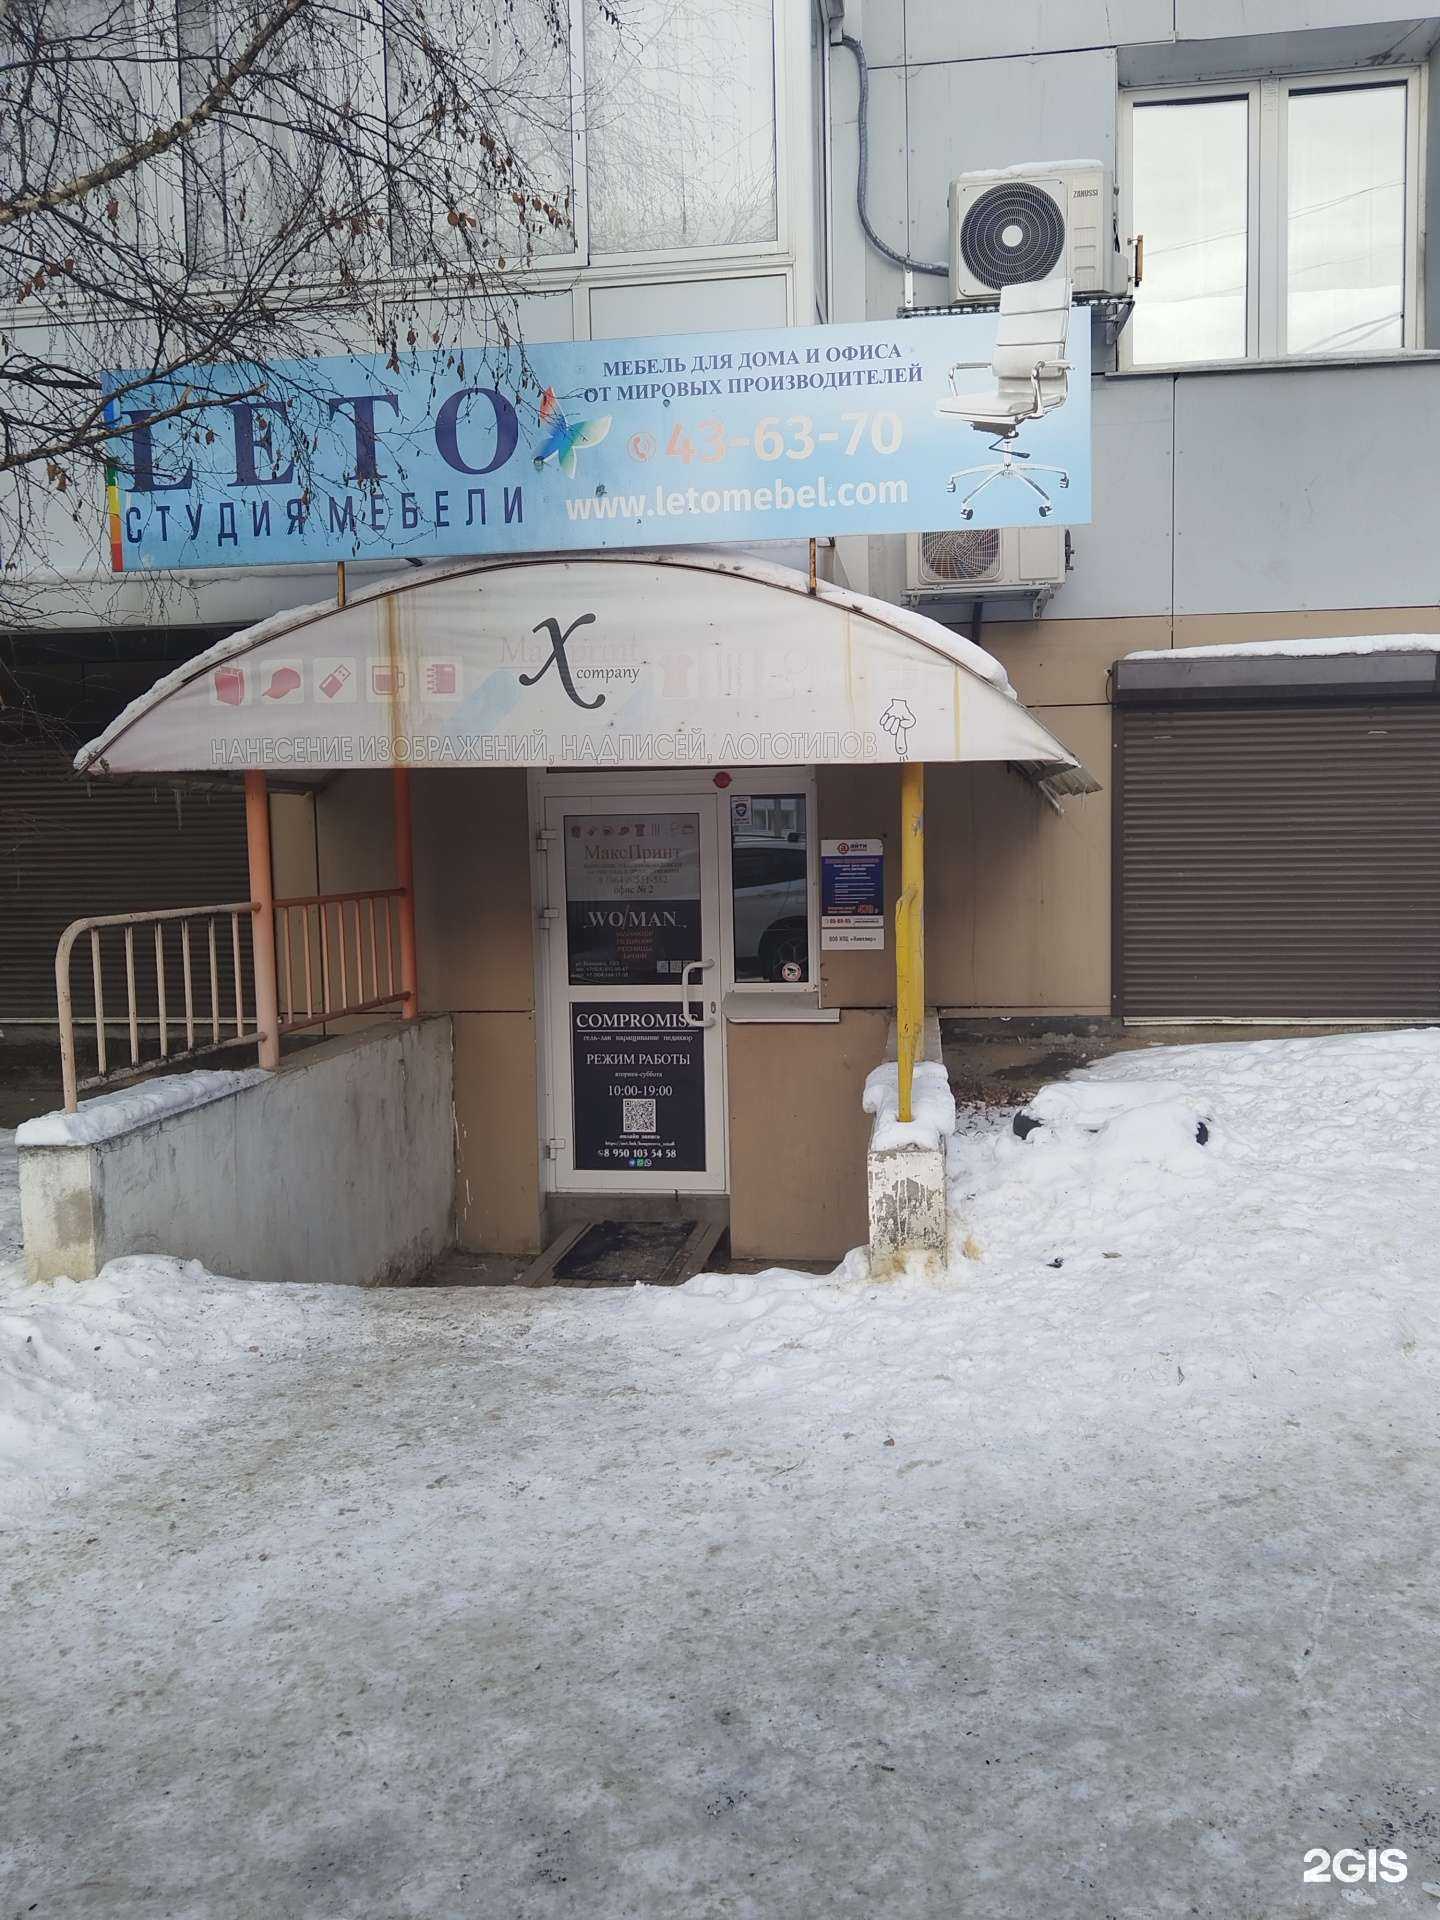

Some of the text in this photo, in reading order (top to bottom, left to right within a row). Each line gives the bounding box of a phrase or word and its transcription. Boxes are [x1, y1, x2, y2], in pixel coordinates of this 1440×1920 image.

[1073, 188, 1099, 199] ZANUSSI
[602, 344, 903, 379] МЕБЕЛЬ ДЛЯ ДОМА И ОФИСА
[583, 365, 924, 404] ОТ МИРОВЫХ ПРОИЗВОДИТЕЛЕЙ
[665, 410, 904, 465] 43-63-70
[566, 476, 909, 521] www.letomebel.com
[125, 486, 524, 548] СТУДИЯ МЕБЕЛИ
[576, 664, 641, 684] company
[210, 728, 878, 767] НАНЕСЕНИЕ ИЗОБРАЖЕНИЙ, НАДПИСЕЙ, ЛОГОТИПОВ
[586, 1053, 691, 1066] РЕЖИМ РАБОТЫ
[608, 1085, 673, 1097] 10:00-19:00
[613, 1149, 630, 1158] 950
[633, 1149, 648, 1158] 103
[651, 1149, 663, 1158] 54
[665, 1149, 677, 1158] 58
